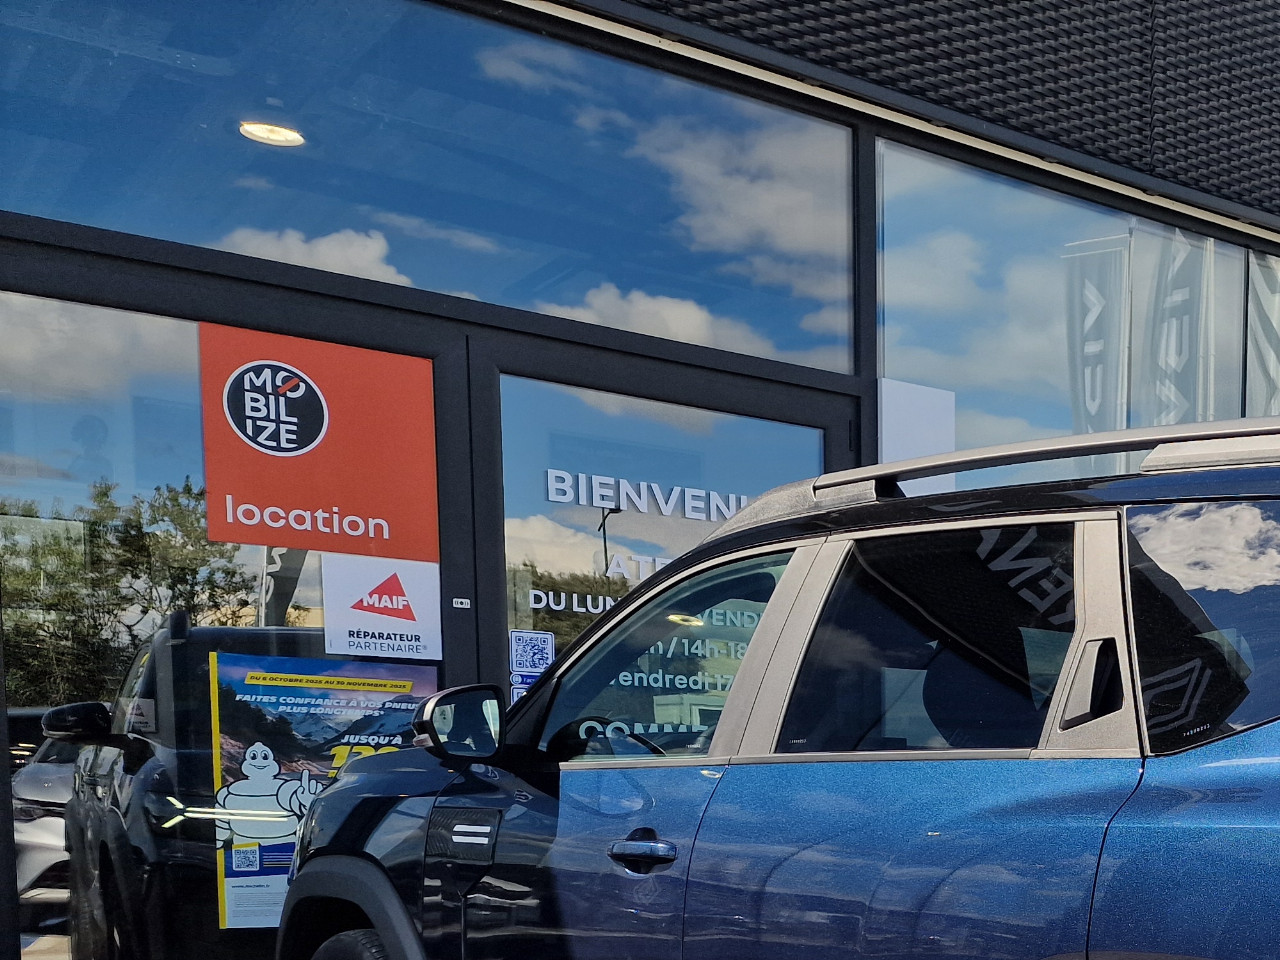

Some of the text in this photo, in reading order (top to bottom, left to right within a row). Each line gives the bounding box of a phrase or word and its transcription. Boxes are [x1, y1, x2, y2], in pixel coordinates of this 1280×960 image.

[244, 390, 298, 423] BIL
[245, 418, 299, 449] IZE
[225, 494, 390, 540] location
[362, 593, 408, 610] MAIF
[529, 589, 567, 611] DU
[694, 607, 763, 628] VEND
[347, 628, 421, 643] RÉPARATEUR
[268, 676, 304, 684] OCTOBRE
[346, 681, 387, 689] NOVEMBRE
[609, 668, 709, 690] endredi
[235, 694, 278, 703] FAITES
[279, 696, 347, 707] CONFIANCE
[348, 698, 357, 707] À
[360, 701, 383, 709] VOS
[277, 705, 308, 714] PLUS
